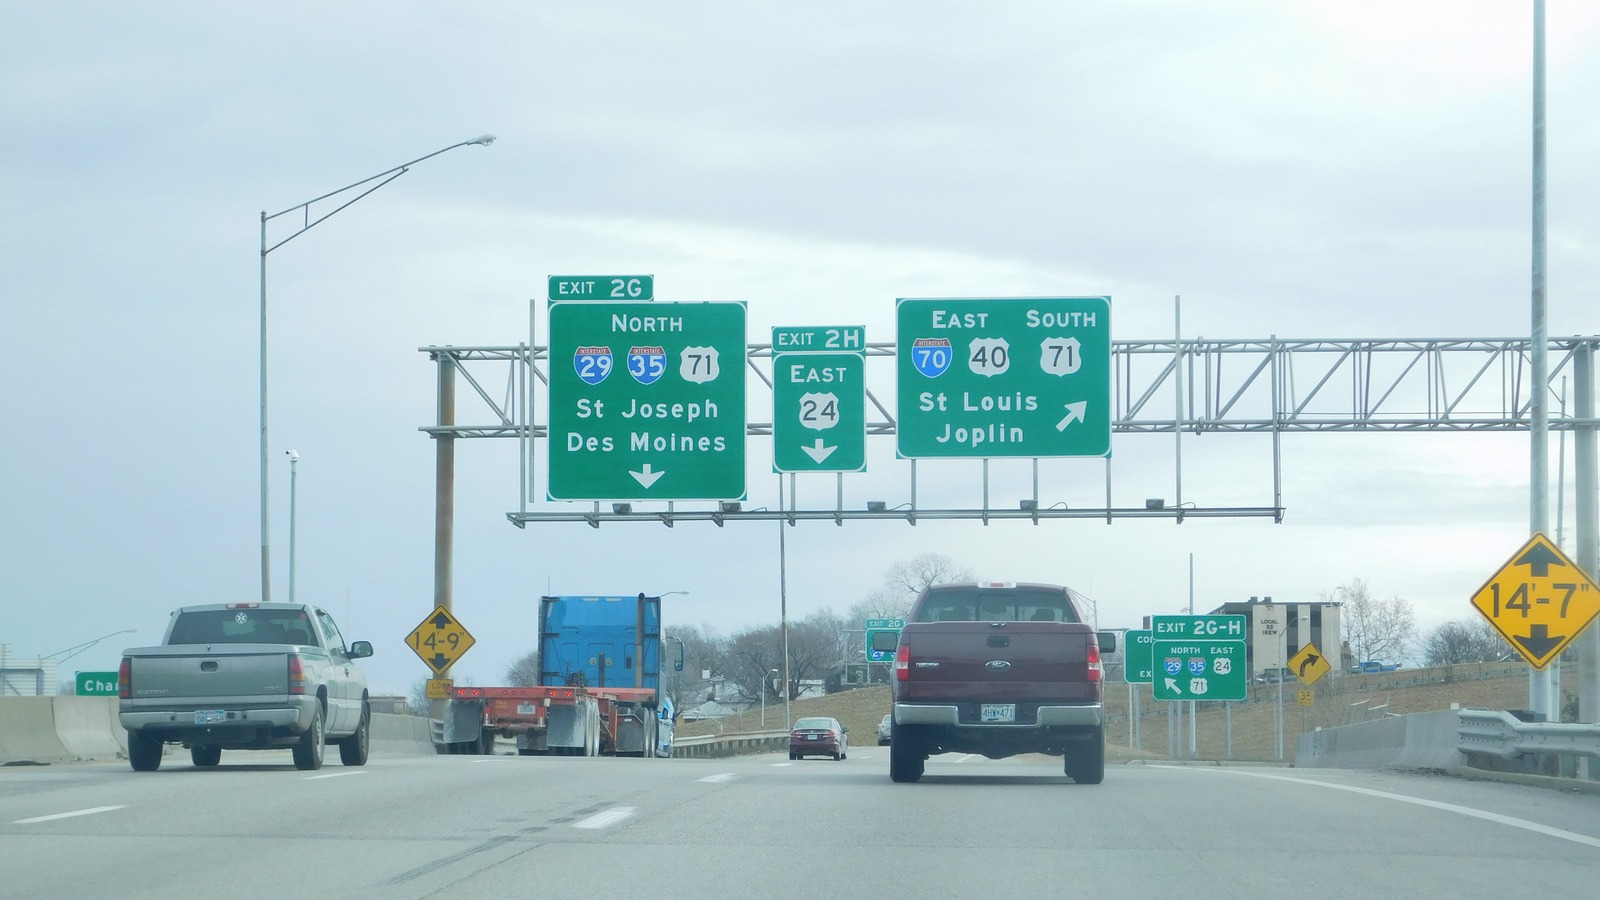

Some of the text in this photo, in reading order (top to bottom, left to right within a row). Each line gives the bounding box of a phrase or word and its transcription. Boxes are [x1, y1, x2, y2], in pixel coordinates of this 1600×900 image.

[559, 278, 642, 298] EXIT 2G
[612, 313, 683, 332] NORTH
[932, 309, 1096, 329] EAST SOUTH
[778, 329, 859, 348] EXIT 2H
[631, 355, 664, 377] 35
[688, 354, 711, 375] 71
[918, 350, 946, 368] 70
[971, 345, 1007, 368] 40
[1048, 345, 1073, 367] 71
[580, 355, 611, 378] 29
[790, 364, 847, 383] EAST
[576, 398, 718, 423] St Joseph
[803, 400, 836, 421] 24
[919, 391, 1038, 411] St Louis
[567, 431, 726, 452] Des Moines
[935, 424, 1024, 448] Joplin
[888, 620, 900, 628] 2G
[1157, 620, 1241, 635] EXIT 2G-H
[1167, 661, 1180, 672] 29
[1190, 661, 1204, 672] 35
[1215, 661, 1230, 671] 24
[1193, 681, 1204, 691] 71
